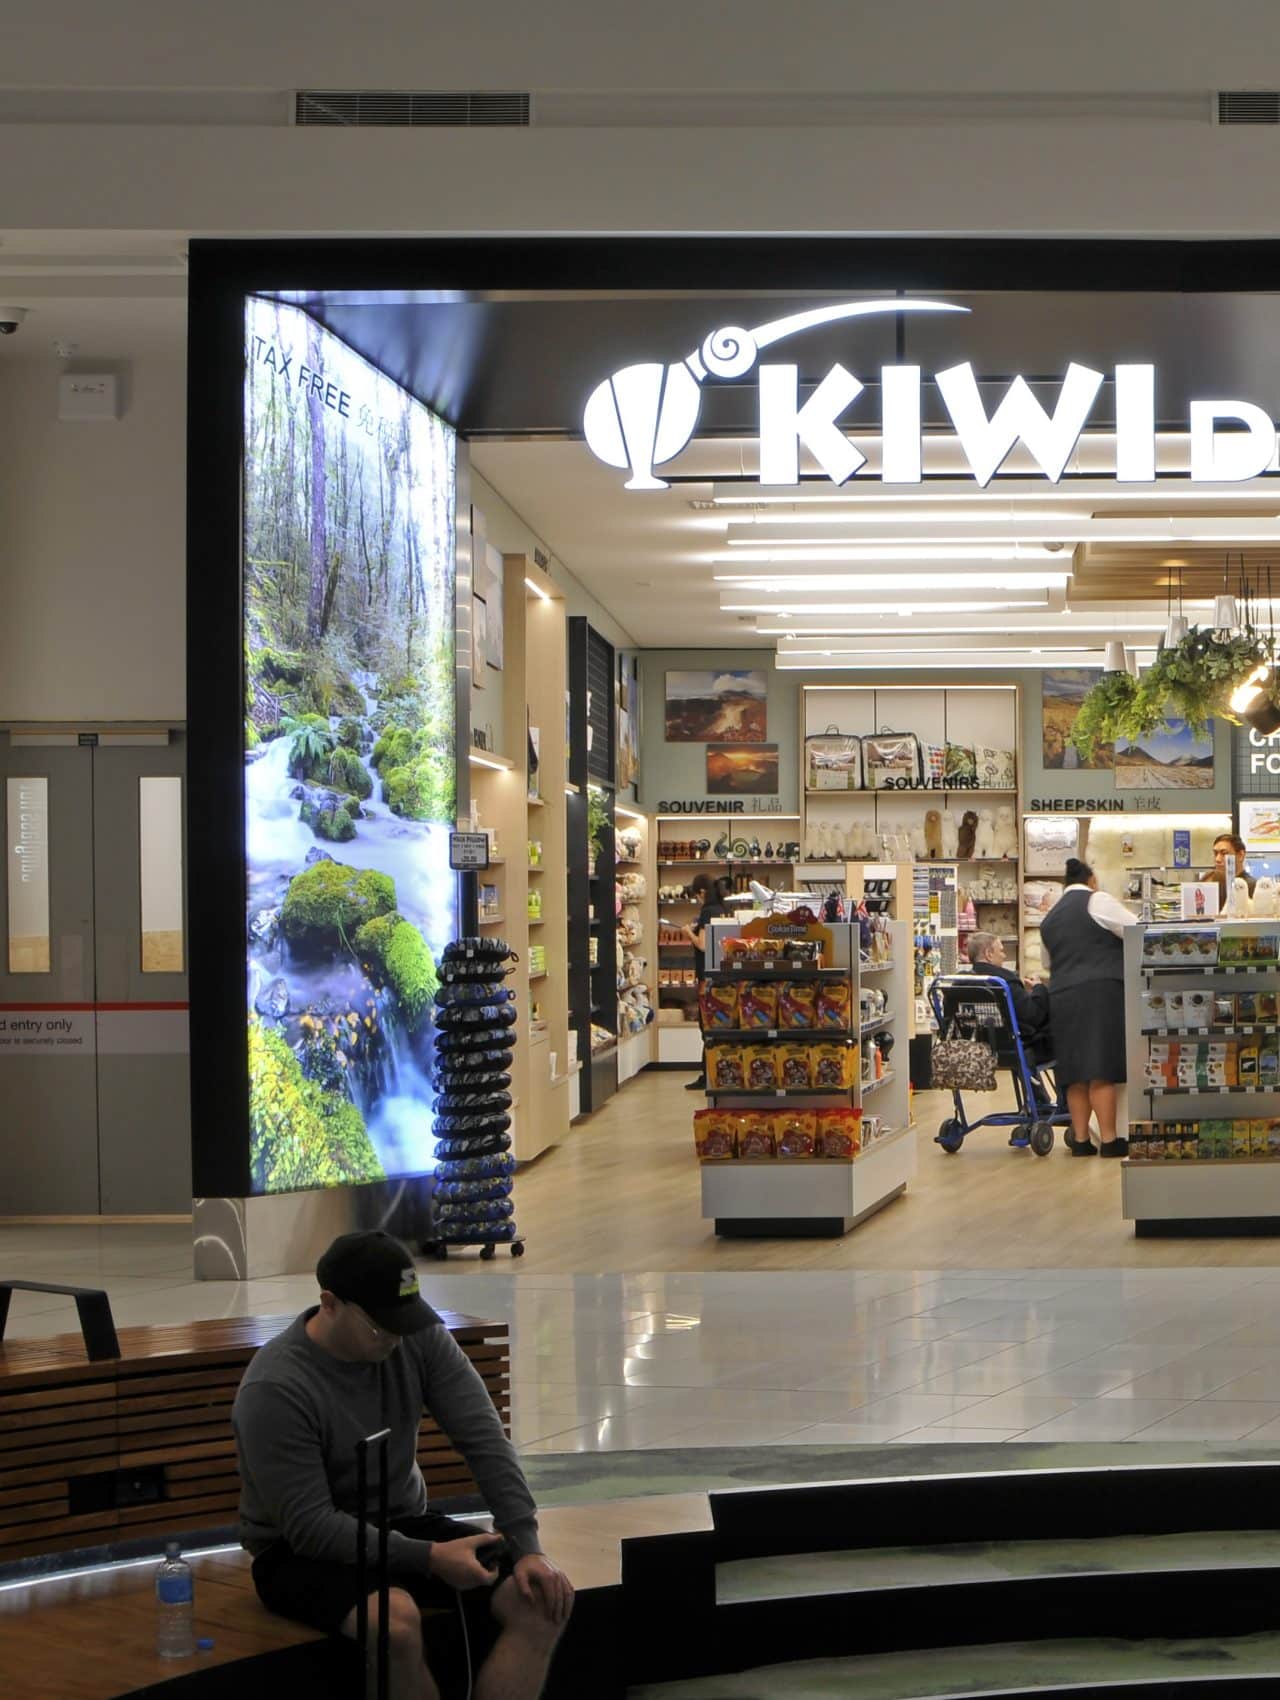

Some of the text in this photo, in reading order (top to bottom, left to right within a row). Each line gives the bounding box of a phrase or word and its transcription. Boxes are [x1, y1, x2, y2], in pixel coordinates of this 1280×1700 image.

[255, 336, 352, 418] TAX FREE
[759, 361, 1156, 488] KIWI
[885, 776, 980, 790] SOUVENIRS
[657, 800, 745, 814] SOUVENIR
[1031, 799, 1124, 811] SHEEPSKIN
[10, 1019, 42, 1032] entry
[46, 1018, 73, 1032] only
